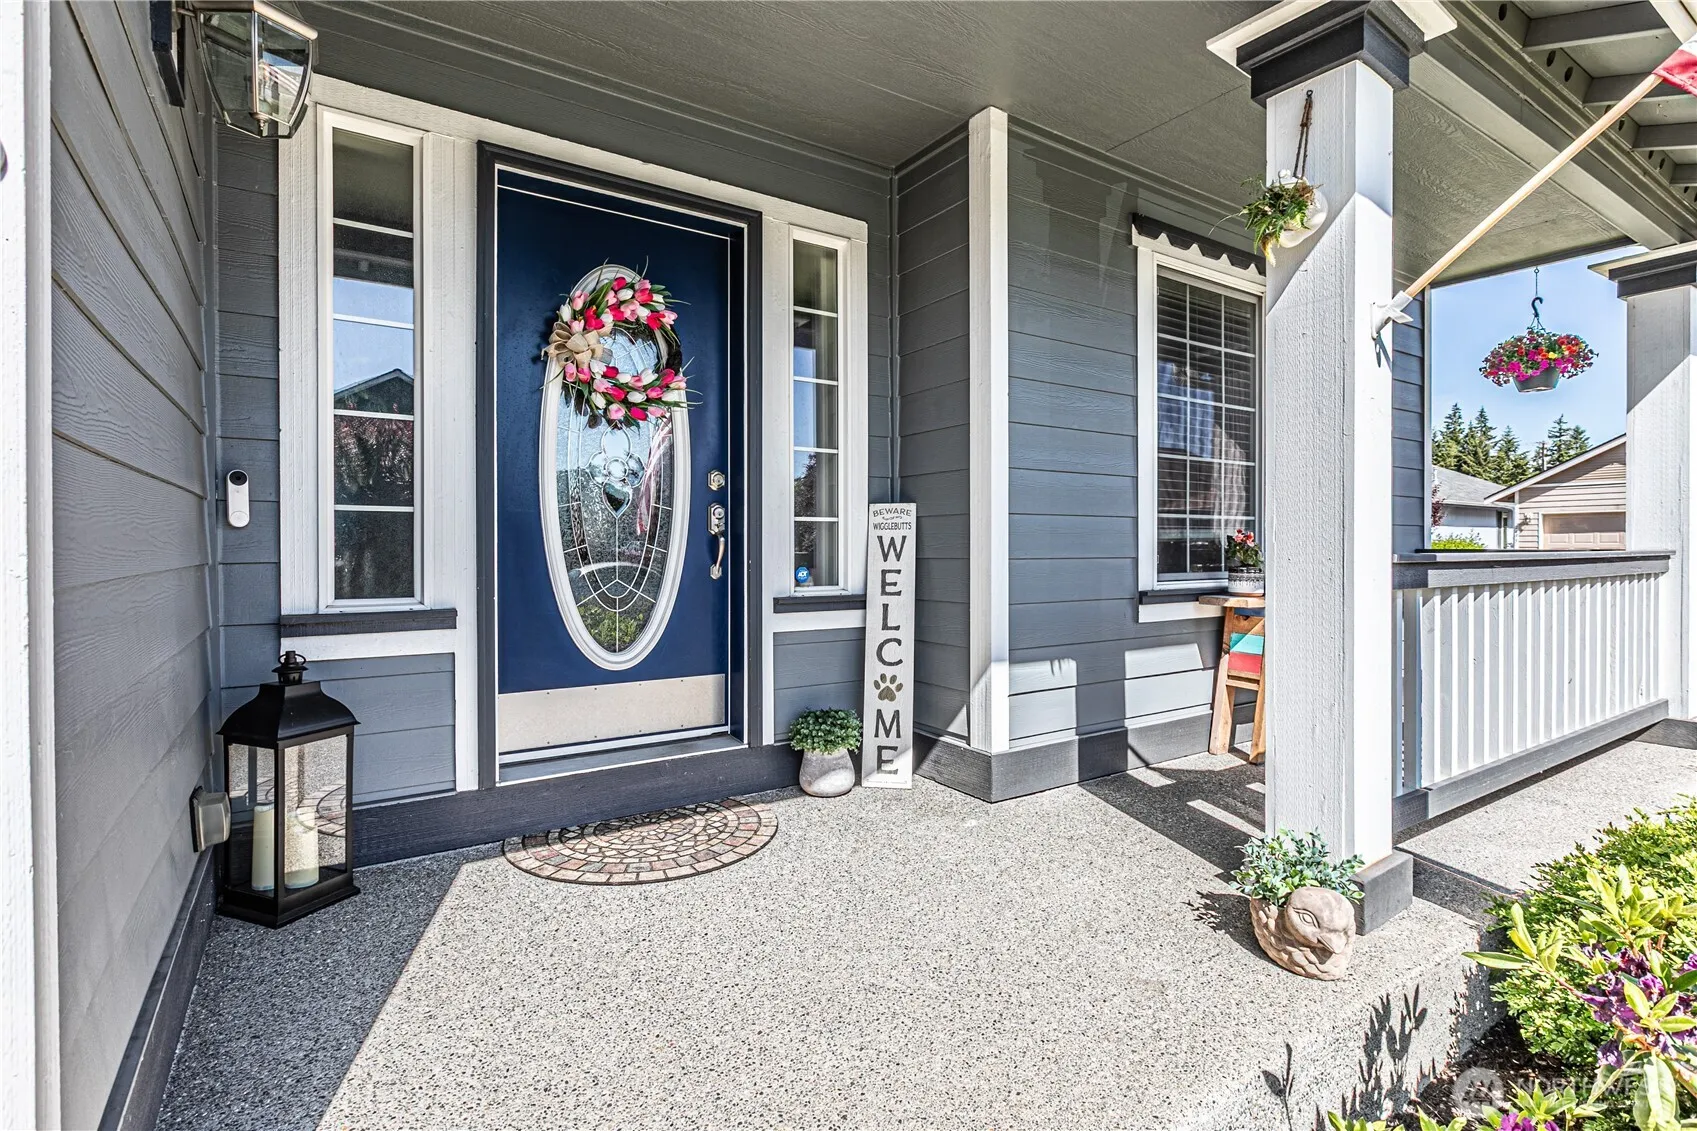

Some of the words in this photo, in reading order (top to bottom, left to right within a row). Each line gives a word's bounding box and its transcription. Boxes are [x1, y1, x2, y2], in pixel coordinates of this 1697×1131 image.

[873, 508, 912, 518] BEWARE
[873, 522, 912, 531] WIGGLEBUTTS
[874, 535, 907, 775] WELCME
